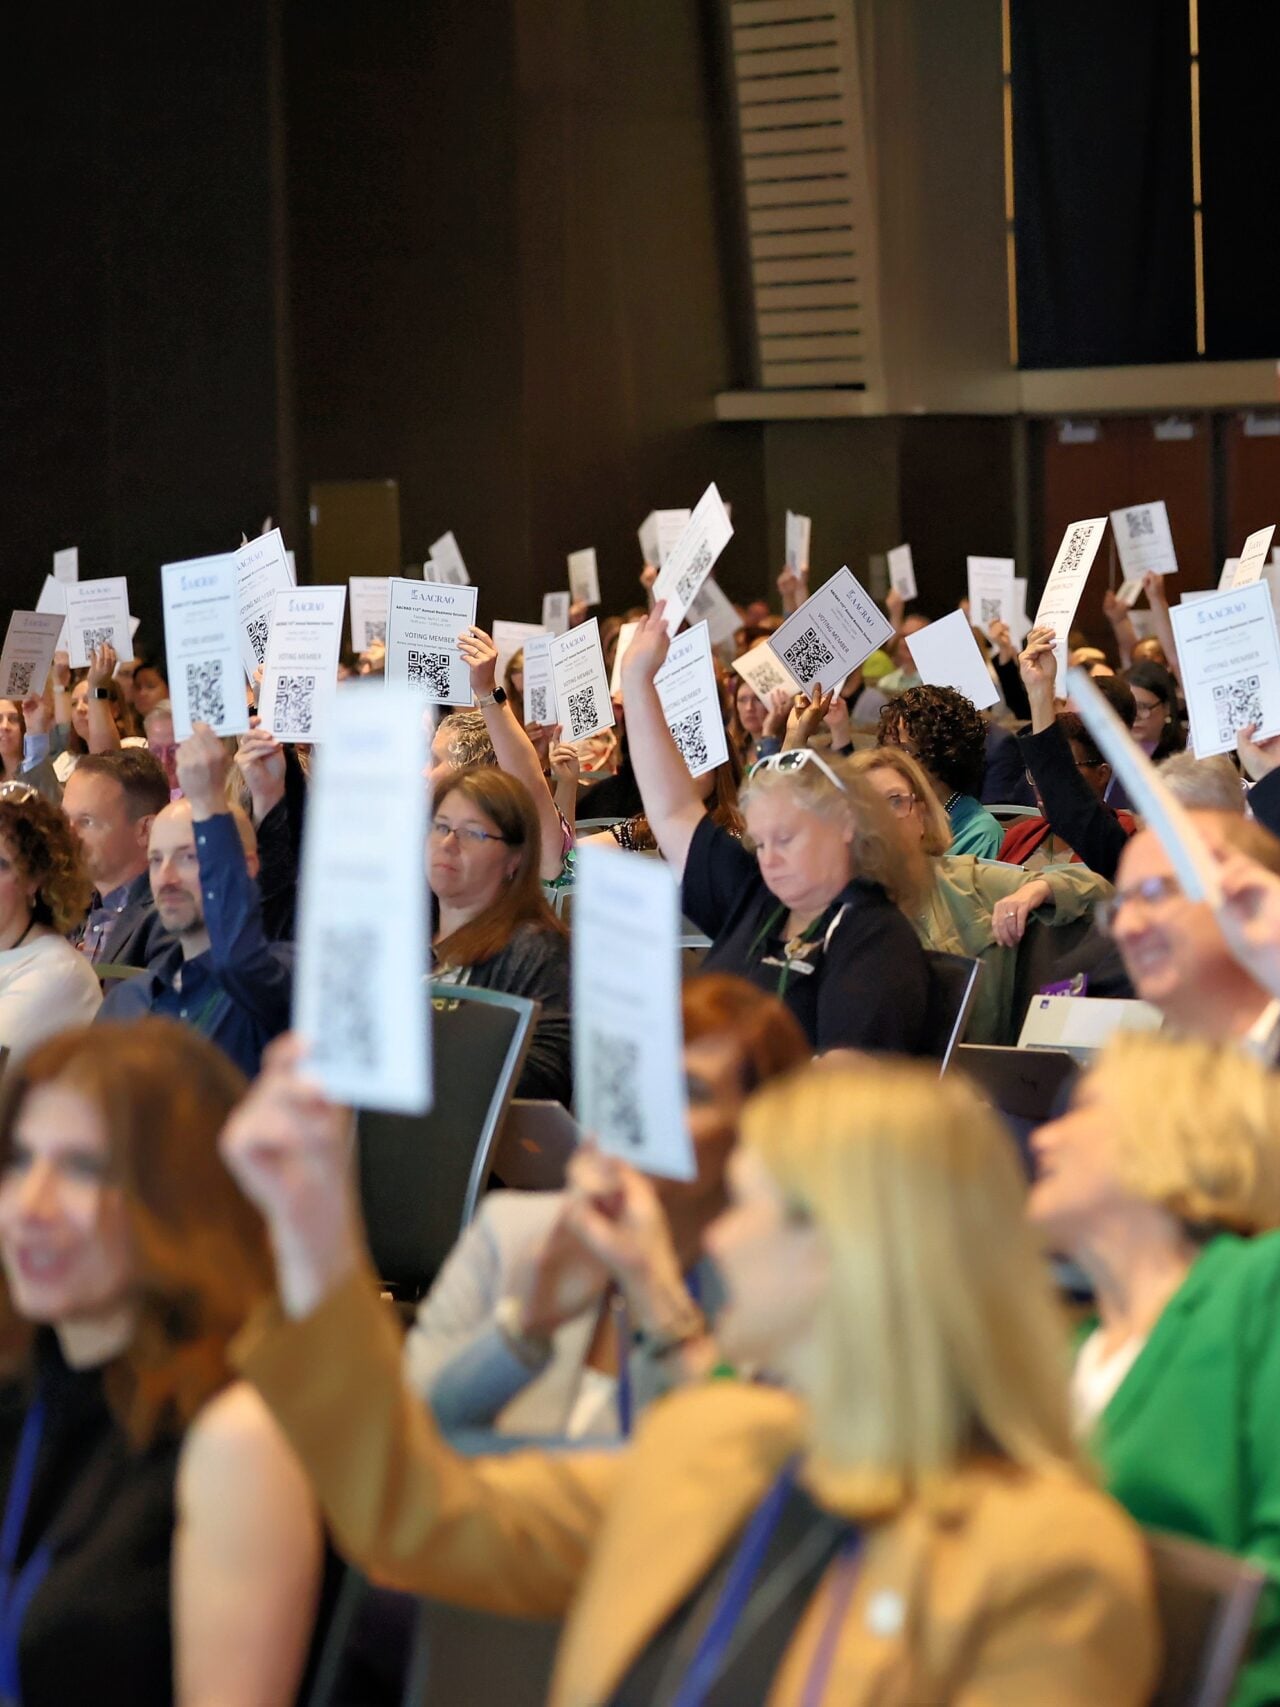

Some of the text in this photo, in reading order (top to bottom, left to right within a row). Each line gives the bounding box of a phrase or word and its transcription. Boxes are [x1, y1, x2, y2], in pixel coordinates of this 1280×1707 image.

[419, 593, 454, 604] AACRAO
[405, 632, 455, 643] VOTING MEMBER
